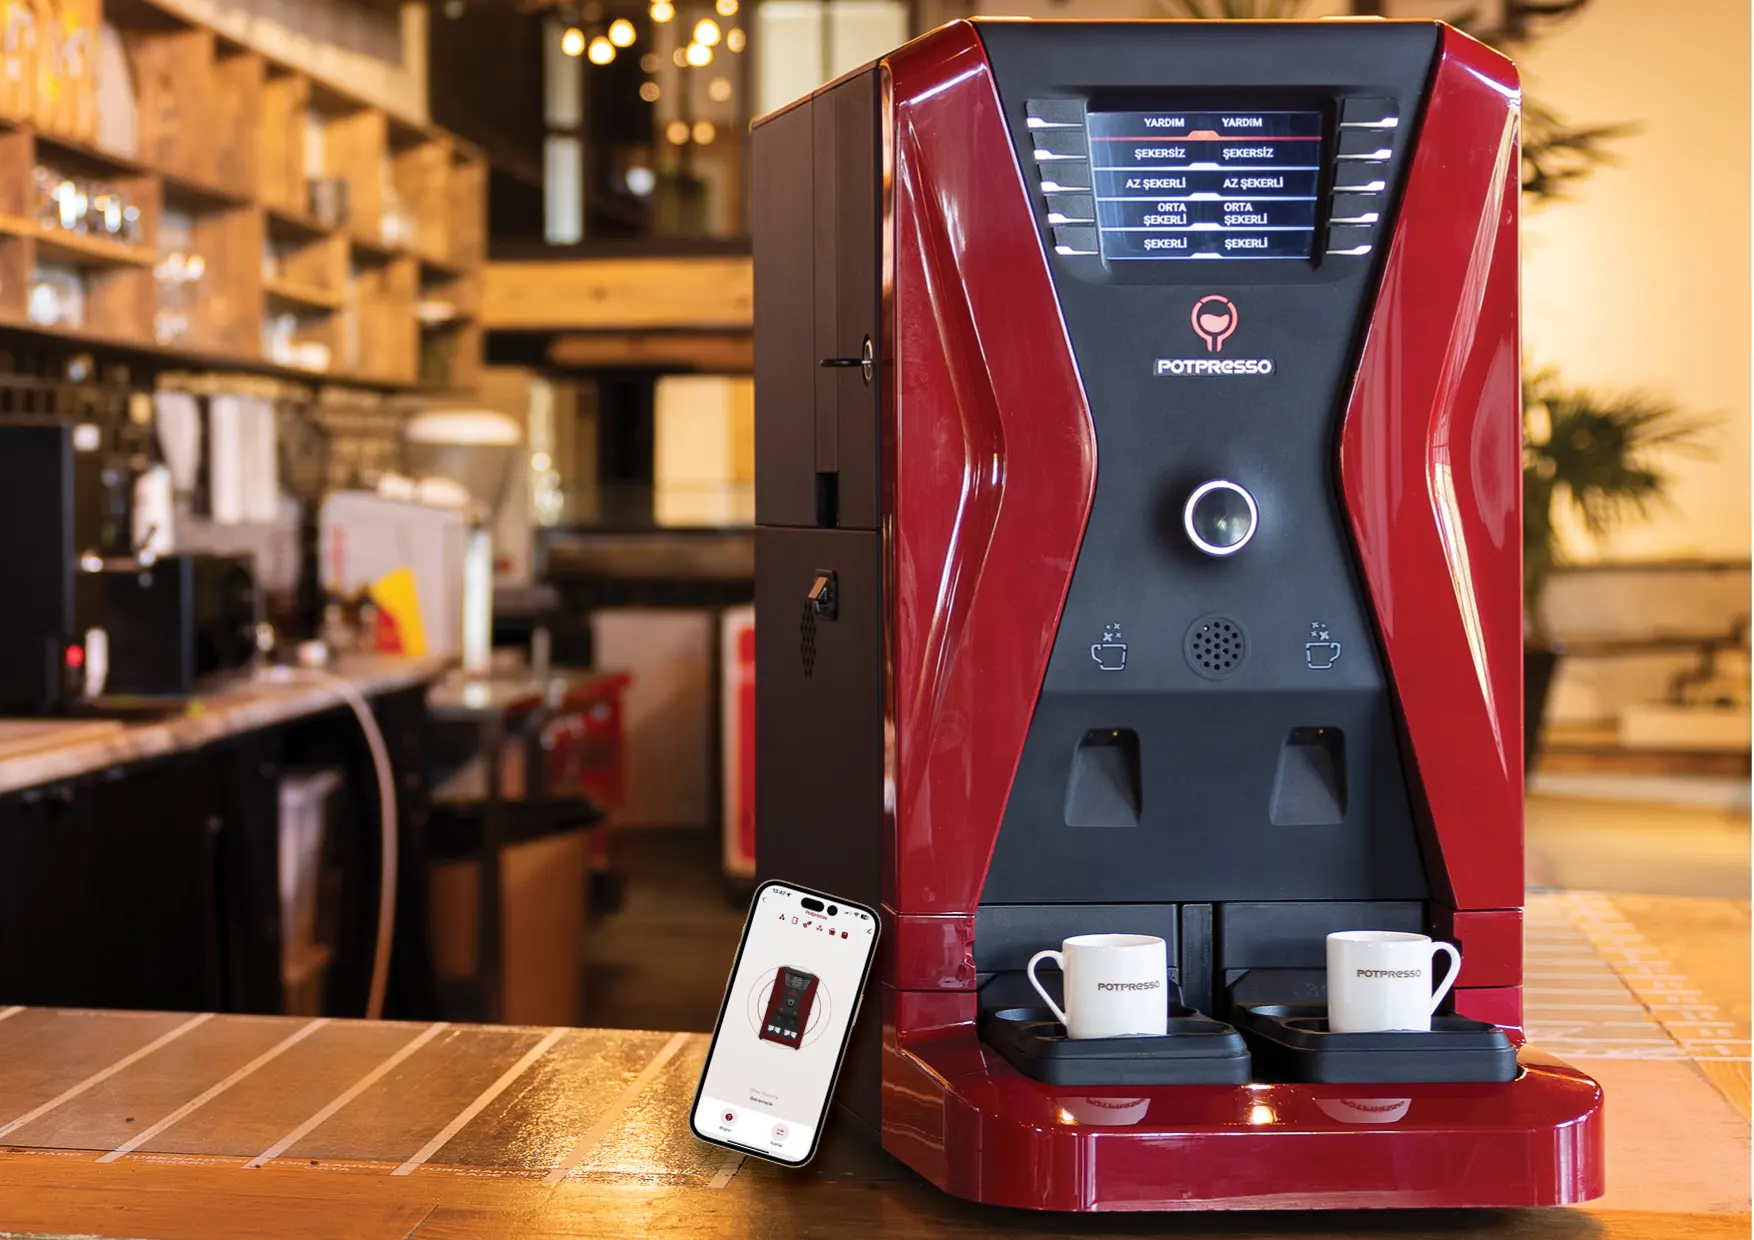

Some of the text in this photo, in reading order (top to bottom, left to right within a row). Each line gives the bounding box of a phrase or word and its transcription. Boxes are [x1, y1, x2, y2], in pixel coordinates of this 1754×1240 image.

[1144, 117, 1185, 127] YARDIM
[1222, 117, 1263, 127] YARDIM
[1134, 147, 1186, 160] ŞEKERSİZ
[1222, 146, 1274, 160] ŞEKERSİZ
[1126, 176, 1186, 190] AZ ŞEKERLİ
[1223, 176, 1284, 190] AZ ŞEKERLİ
[1157, 202, 1187, 212] ORTA
[1223, 202, 1253, 212] ORTA
[1143, 213, 1187, 226] ŞEKERLİ
[1224, 212, 1267, 226] ŞEKERLİ
[1144, 237, 1187, 250] ŞEKERLİ
[1224, 237, 1268, 250] ŞEKERLİ
